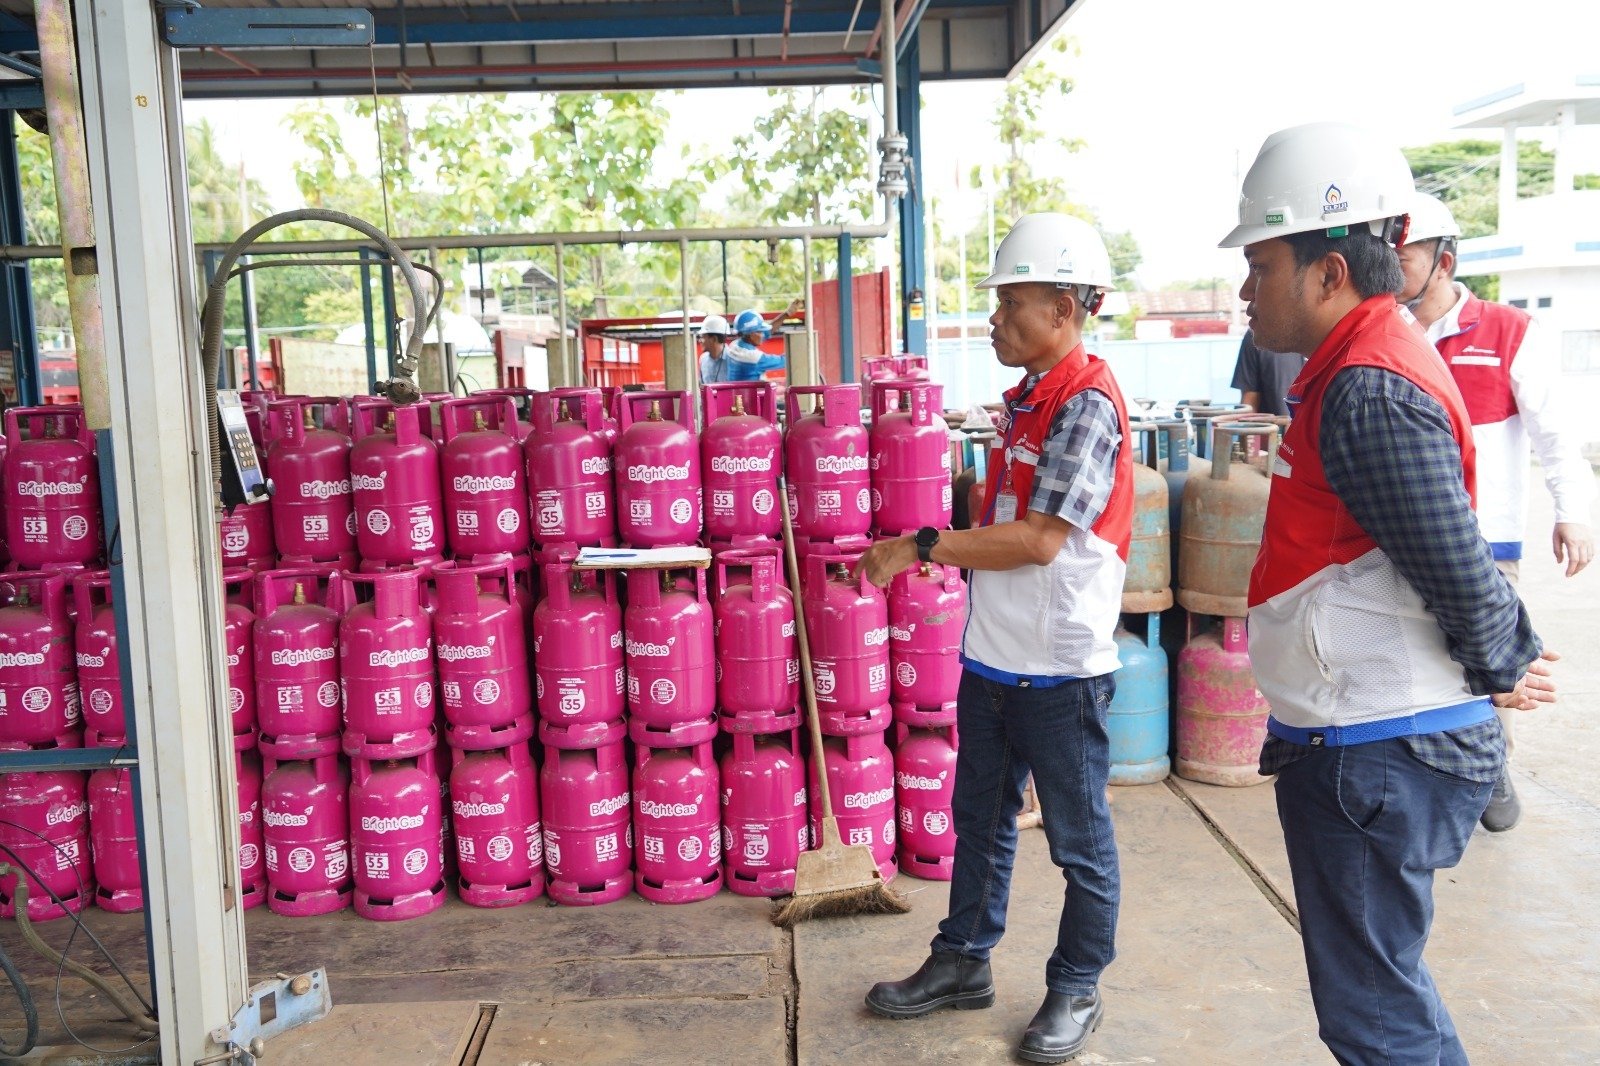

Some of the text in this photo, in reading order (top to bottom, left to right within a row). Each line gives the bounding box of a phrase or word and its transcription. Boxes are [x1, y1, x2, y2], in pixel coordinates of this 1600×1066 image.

[135, 95, 148, 108] 13
[1266, 215, 1283, 223] MSA
[712, 456, 771, 473] Bright Gas
[817, 457, 852, 473] Bright
[629, 466, 689, 482] Bright Gas
[19, 482, 84, 497] Bright Gas
[302, 482, 340, 498] Bright
[454, 477, 515, 494] Bright Gas
[273, 648, 334, 667] Bright Gas
[370, 648, 428, 668] Bright Gas
[438, 645, 491, 662] Bright Gas
[645, 644, 668, 657] Gas
[16, 652, 42, 666] Gas
[84, 654, 103, 667] Gas
[561, 698, 581, 711] 135
[918, 776, 941, 790] Gas
[846, 791, 880, 809] Bright
[480, 802, 504, 816] Gas
[640, 801, 698, 818] Bright Gas
[283, 814, 307, 826] Gas
[363, 814, 424, 834] Bright Gas
[746, 844, 764, 856] 135
